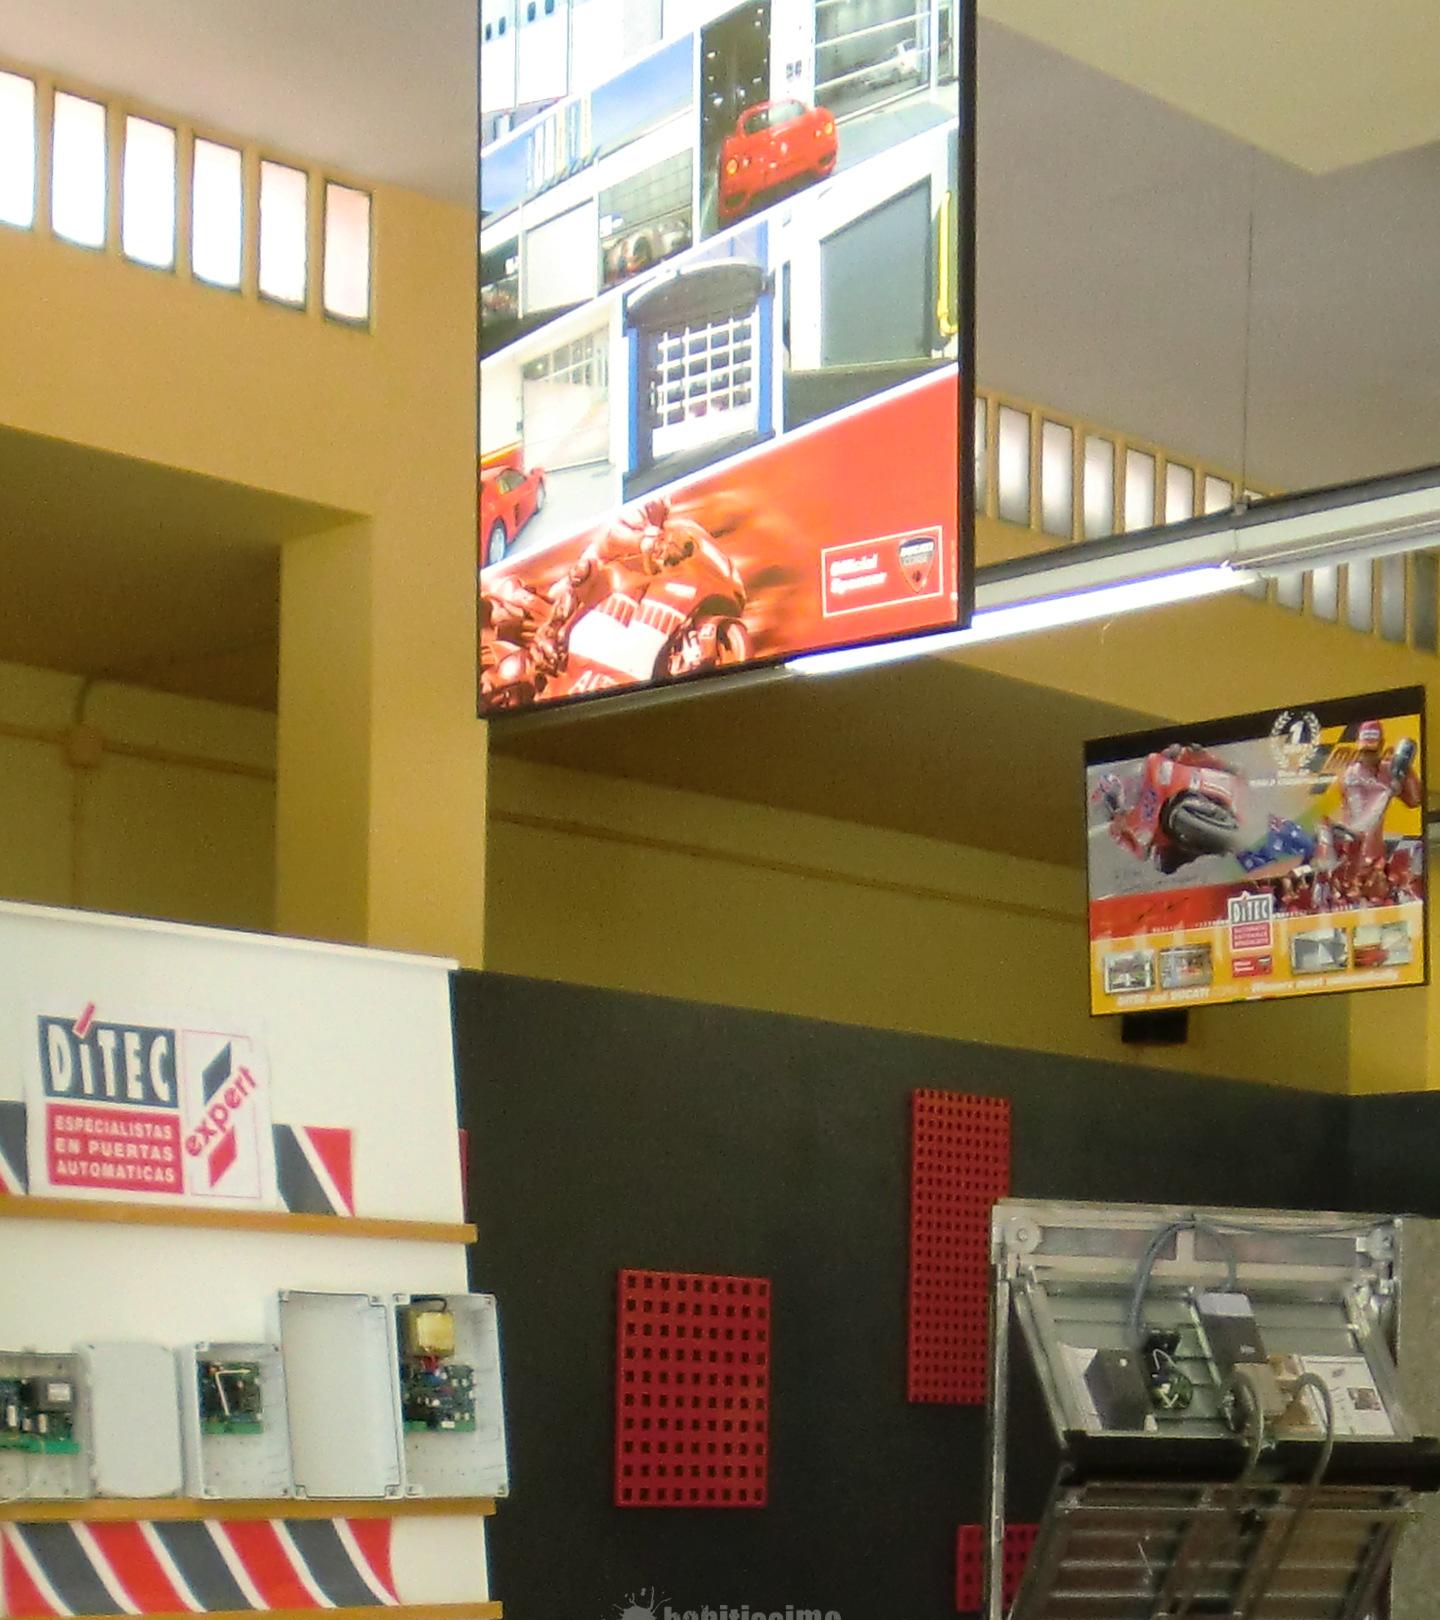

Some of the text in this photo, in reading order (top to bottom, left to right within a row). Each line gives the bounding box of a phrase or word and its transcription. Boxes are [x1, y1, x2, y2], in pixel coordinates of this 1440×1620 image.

[184, 1064, 258, 1157] expert
[54, 1115, 173, 1139] ESPECIALISTAS
[54, 1137, 174, 1162] EN PUERTAS
[56, 1160, 175, 1183] AUTOMATICAS
